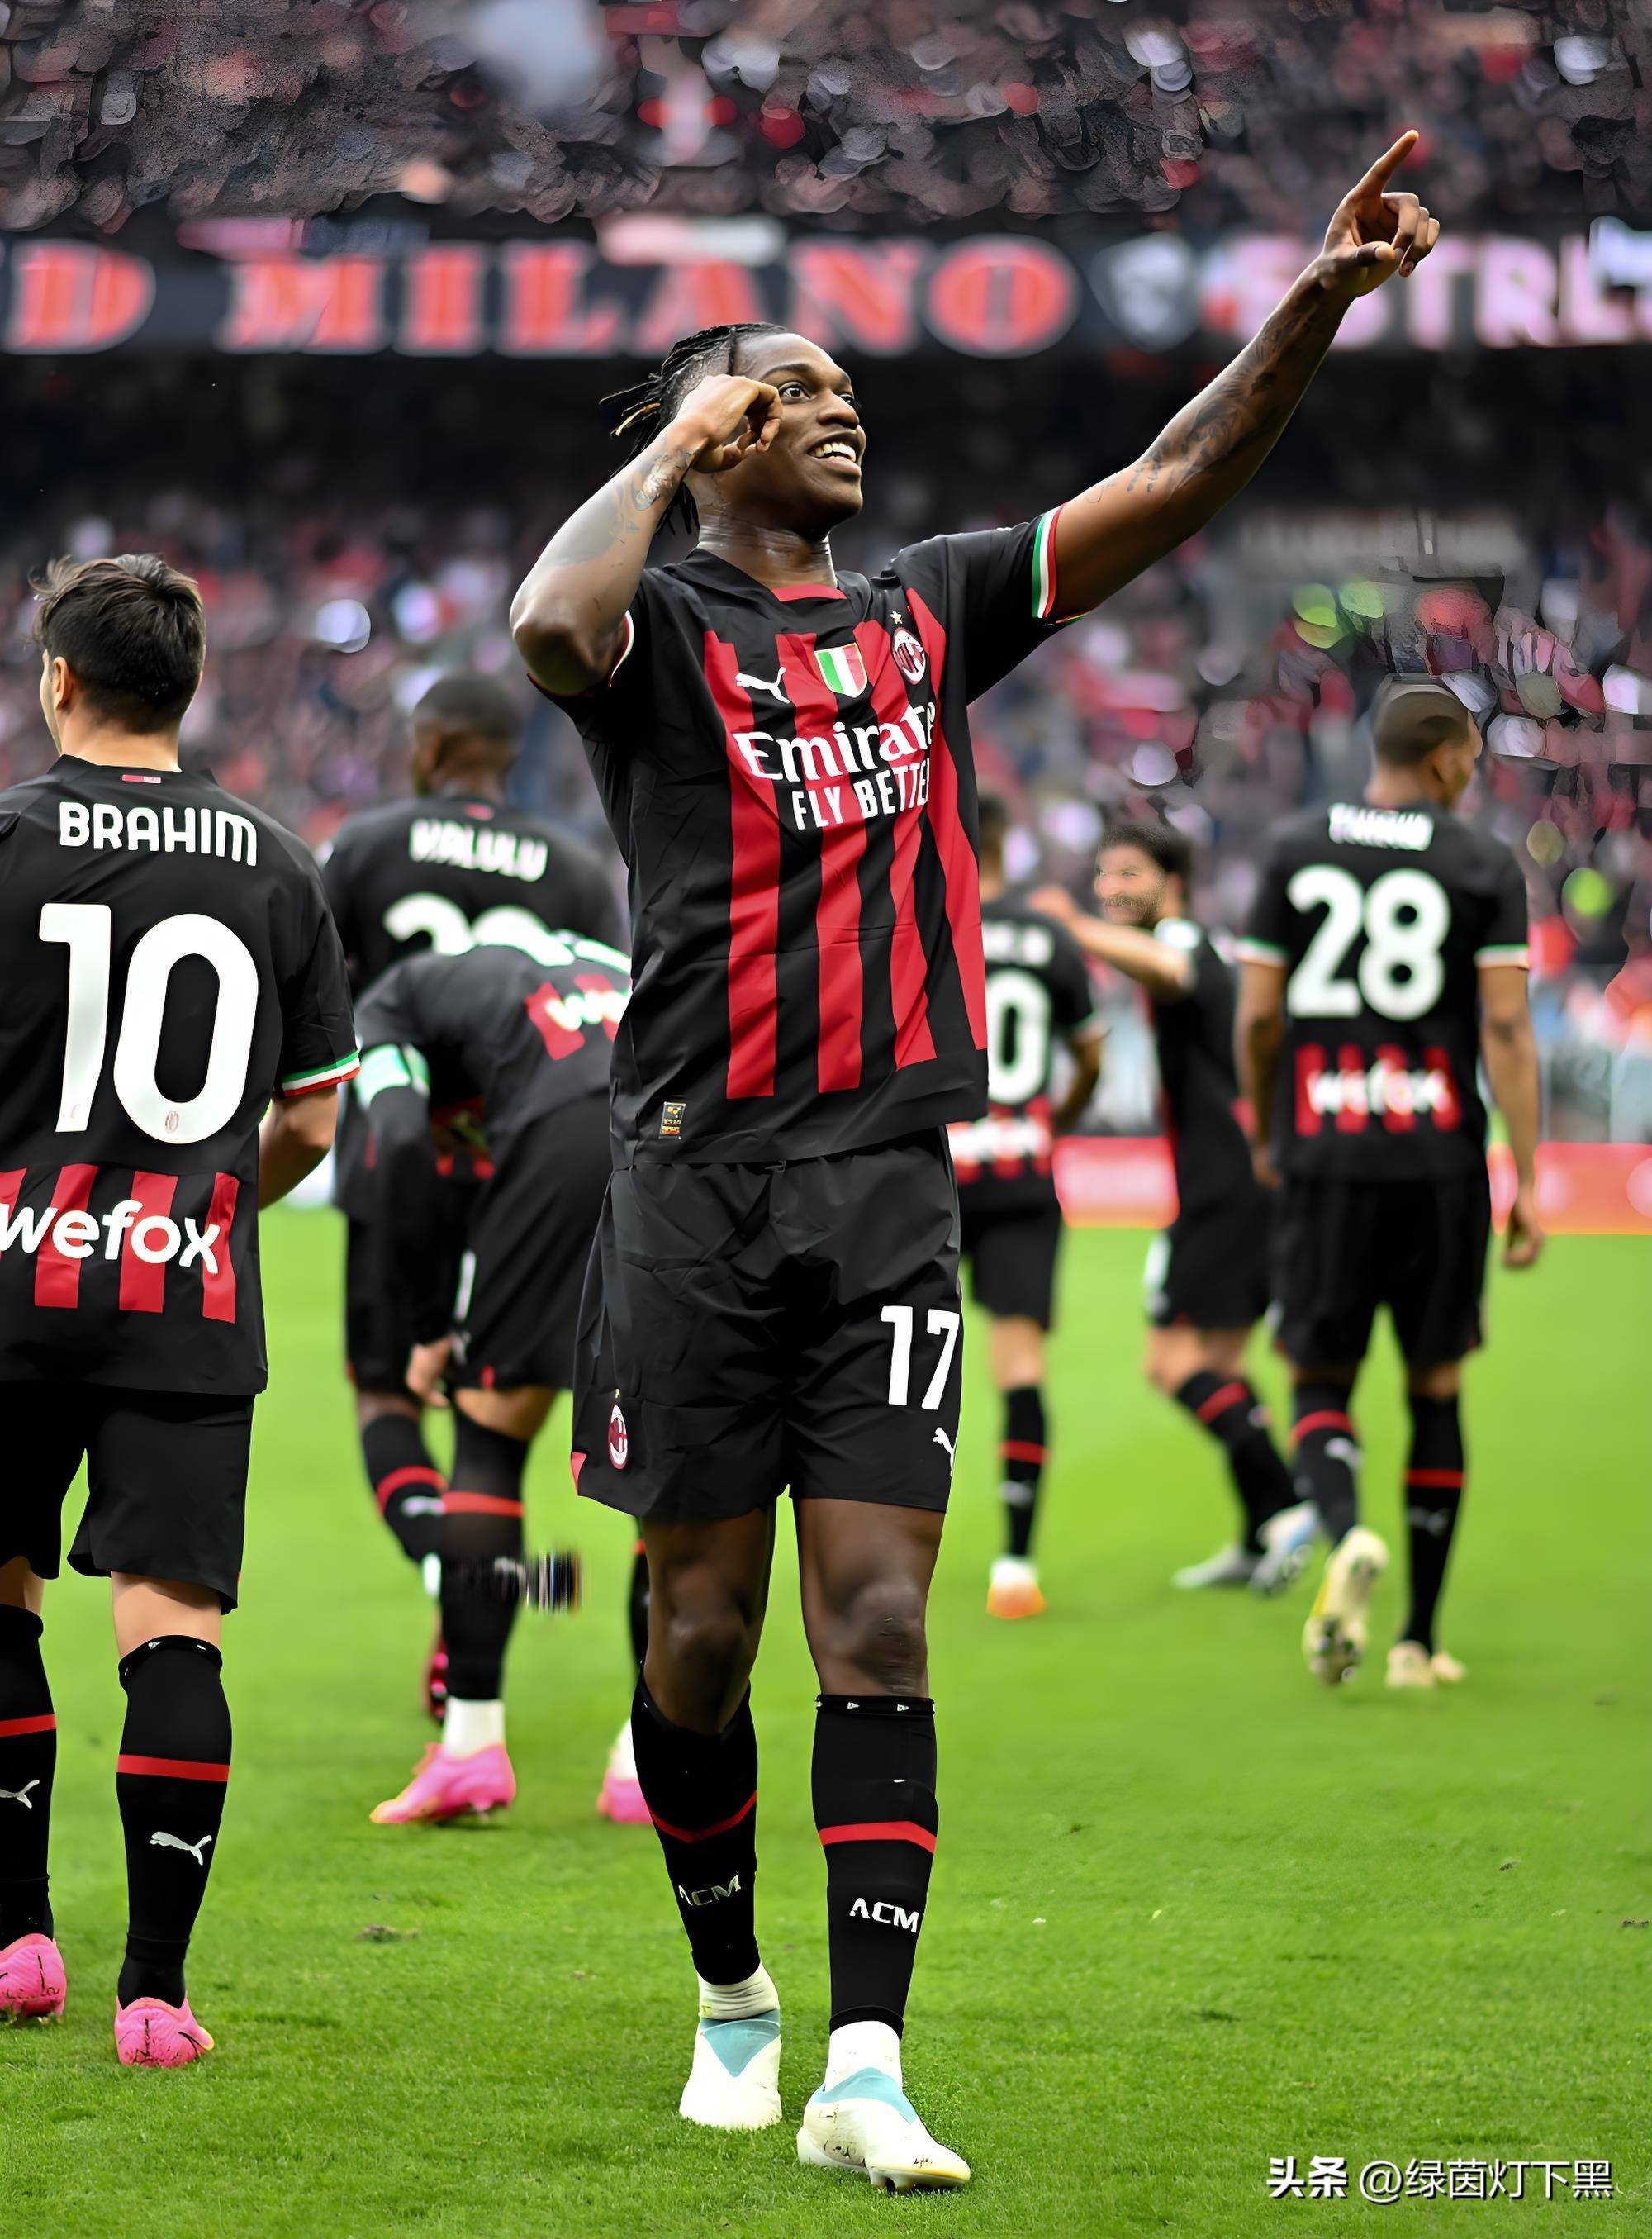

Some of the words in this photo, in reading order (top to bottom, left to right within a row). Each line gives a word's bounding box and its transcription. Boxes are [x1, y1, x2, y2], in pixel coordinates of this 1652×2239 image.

[215, 235, 1079, 359] MILANO
[59, 801, 258, 866] BRAHIM
[790, 786, 845, 830] FLY
[1286, 863, 1450, 1021] 28
[39, 902, 259, 1143] 10
[0, 1199, 221, 1274] wefox
[880, 1305, 960, 1410] 17
[849, 1897, 919, 1933] ACM
